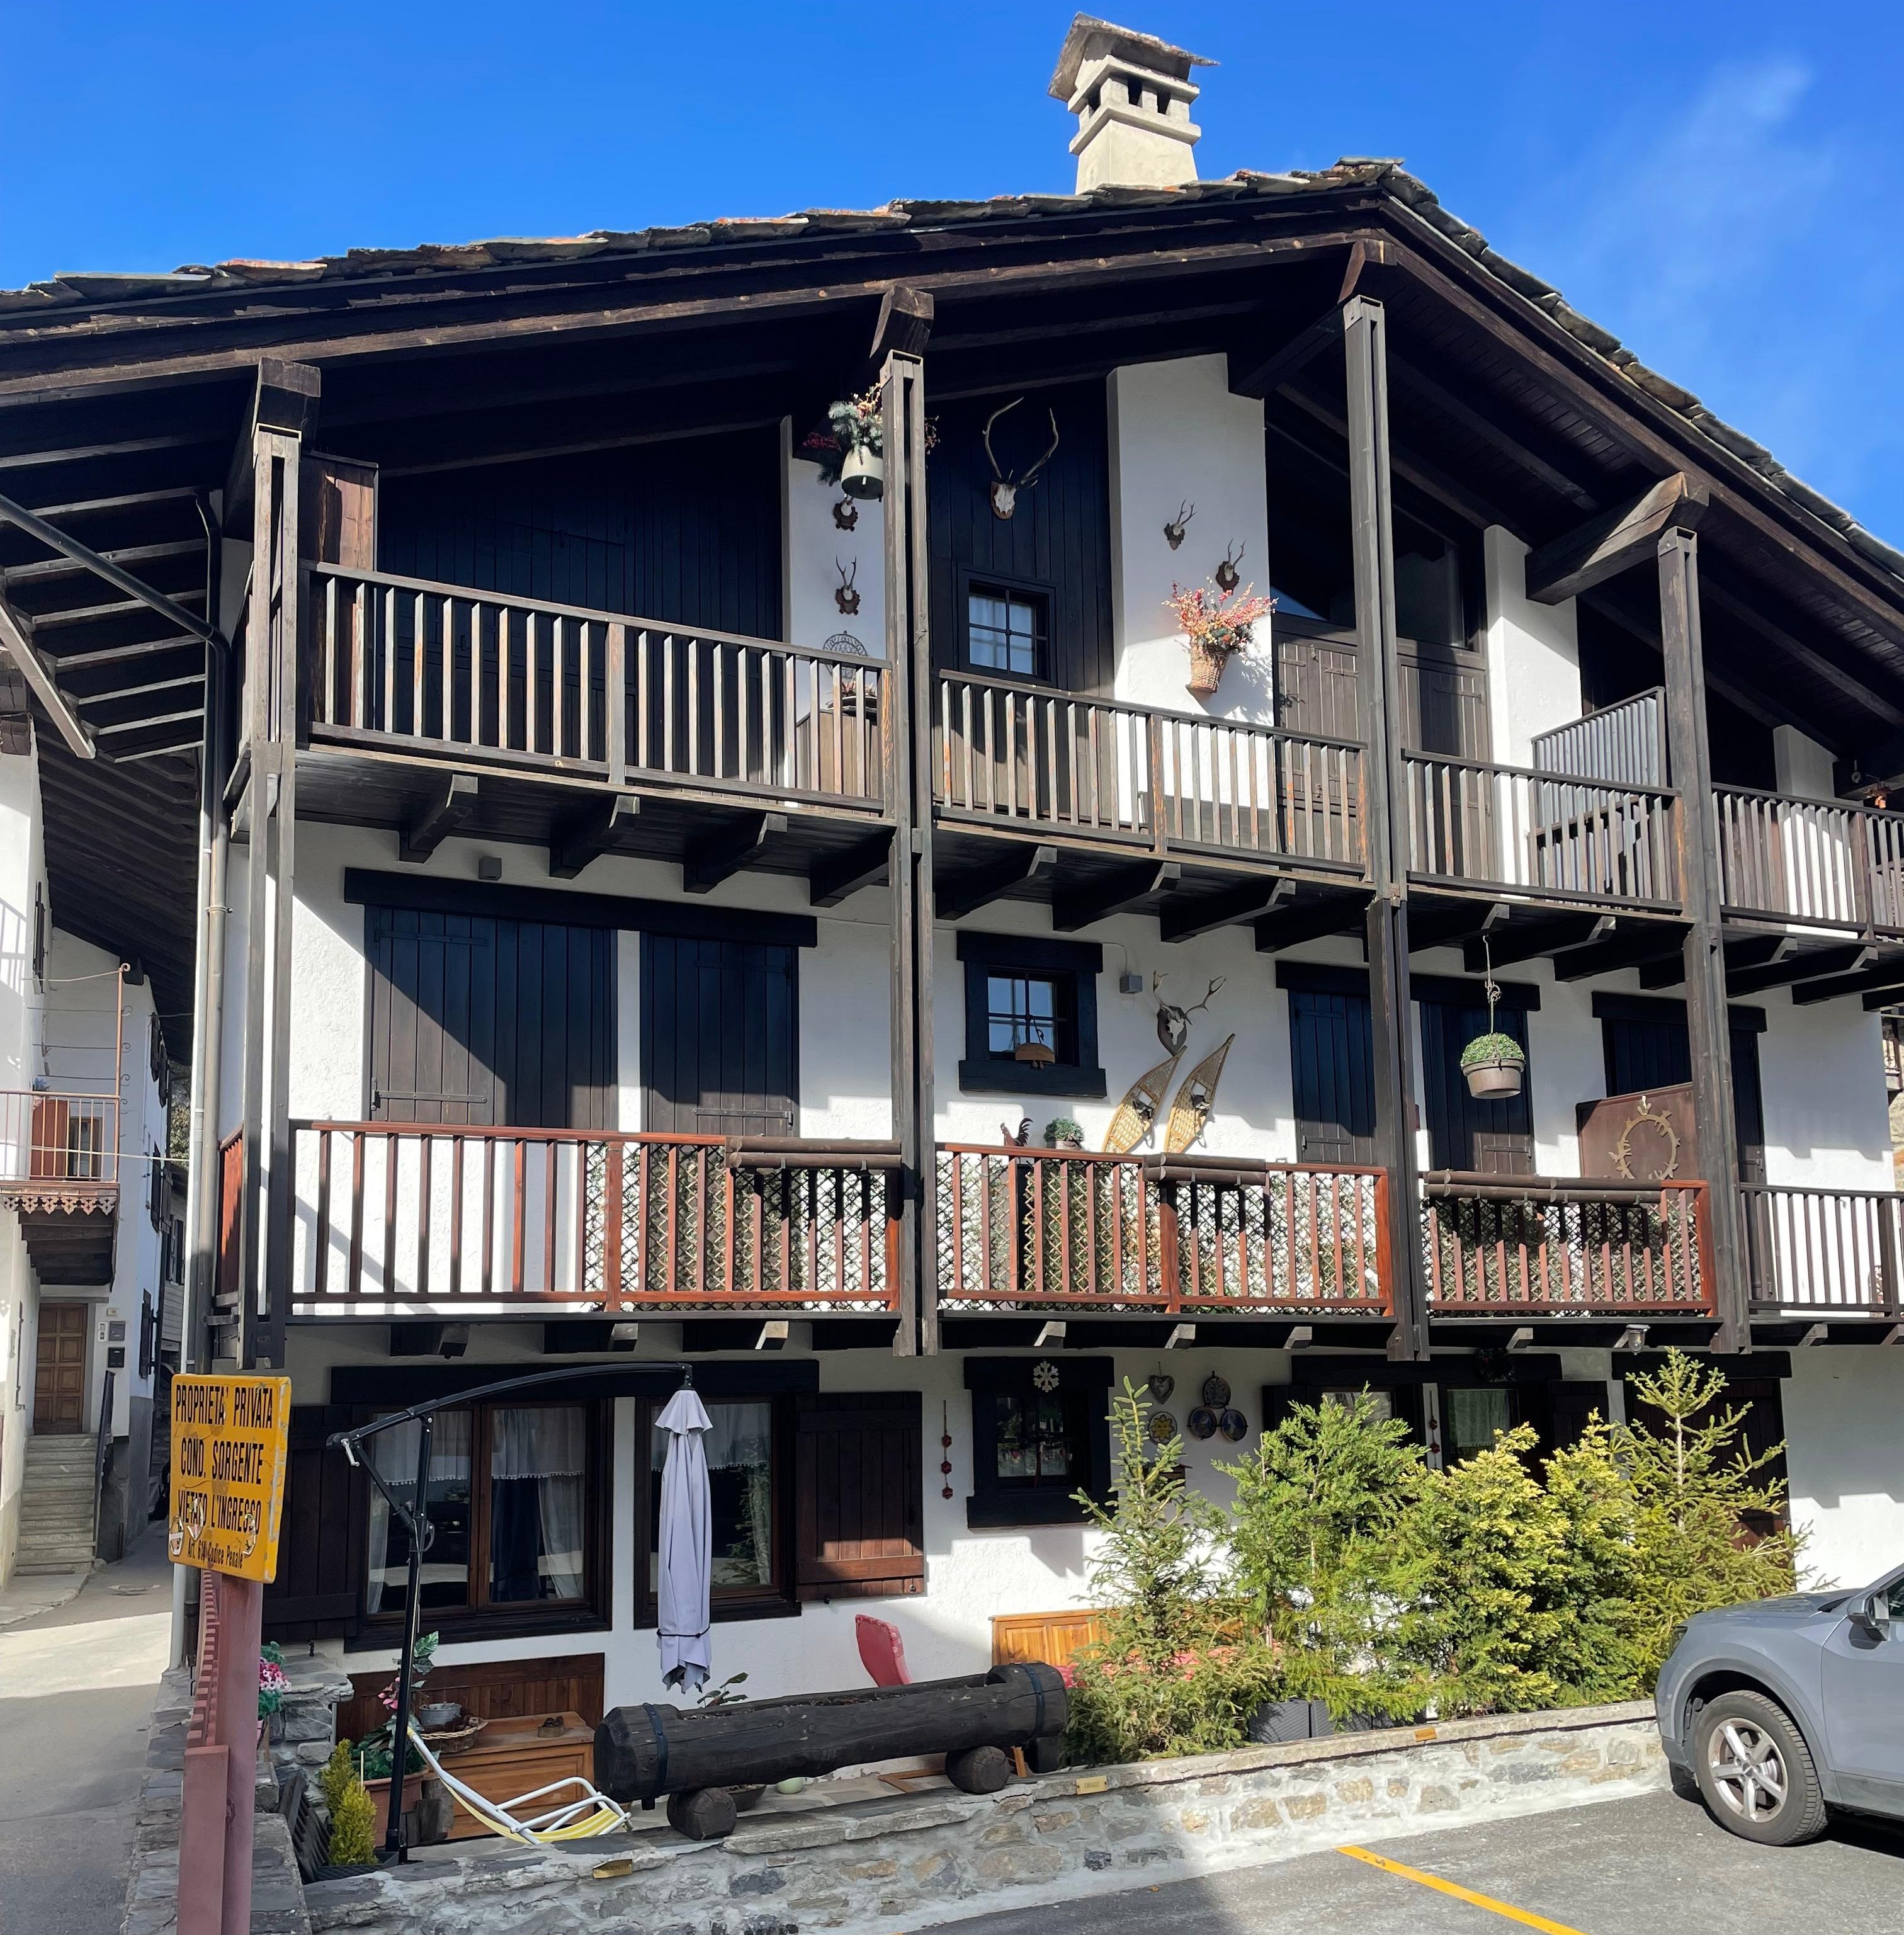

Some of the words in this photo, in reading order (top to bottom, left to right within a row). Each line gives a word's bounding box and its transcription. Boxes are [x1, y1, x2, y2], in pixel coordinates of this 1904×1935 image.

[176, 1384, 229, 1425] PROPRIETA'
[233, 1387, 273, 1429] PRIVATA
[181, 1437, 206, 1478] COND.
[212, 1439, 264, 1485] SORGENTE
[178, 1489, 207, 1526] VIETATO
[211, 1494, 261, 1535] L'INGRESSO
[207, 1541, 224, 1565] Codice
[226, 1545, 244, 1569] Penale
